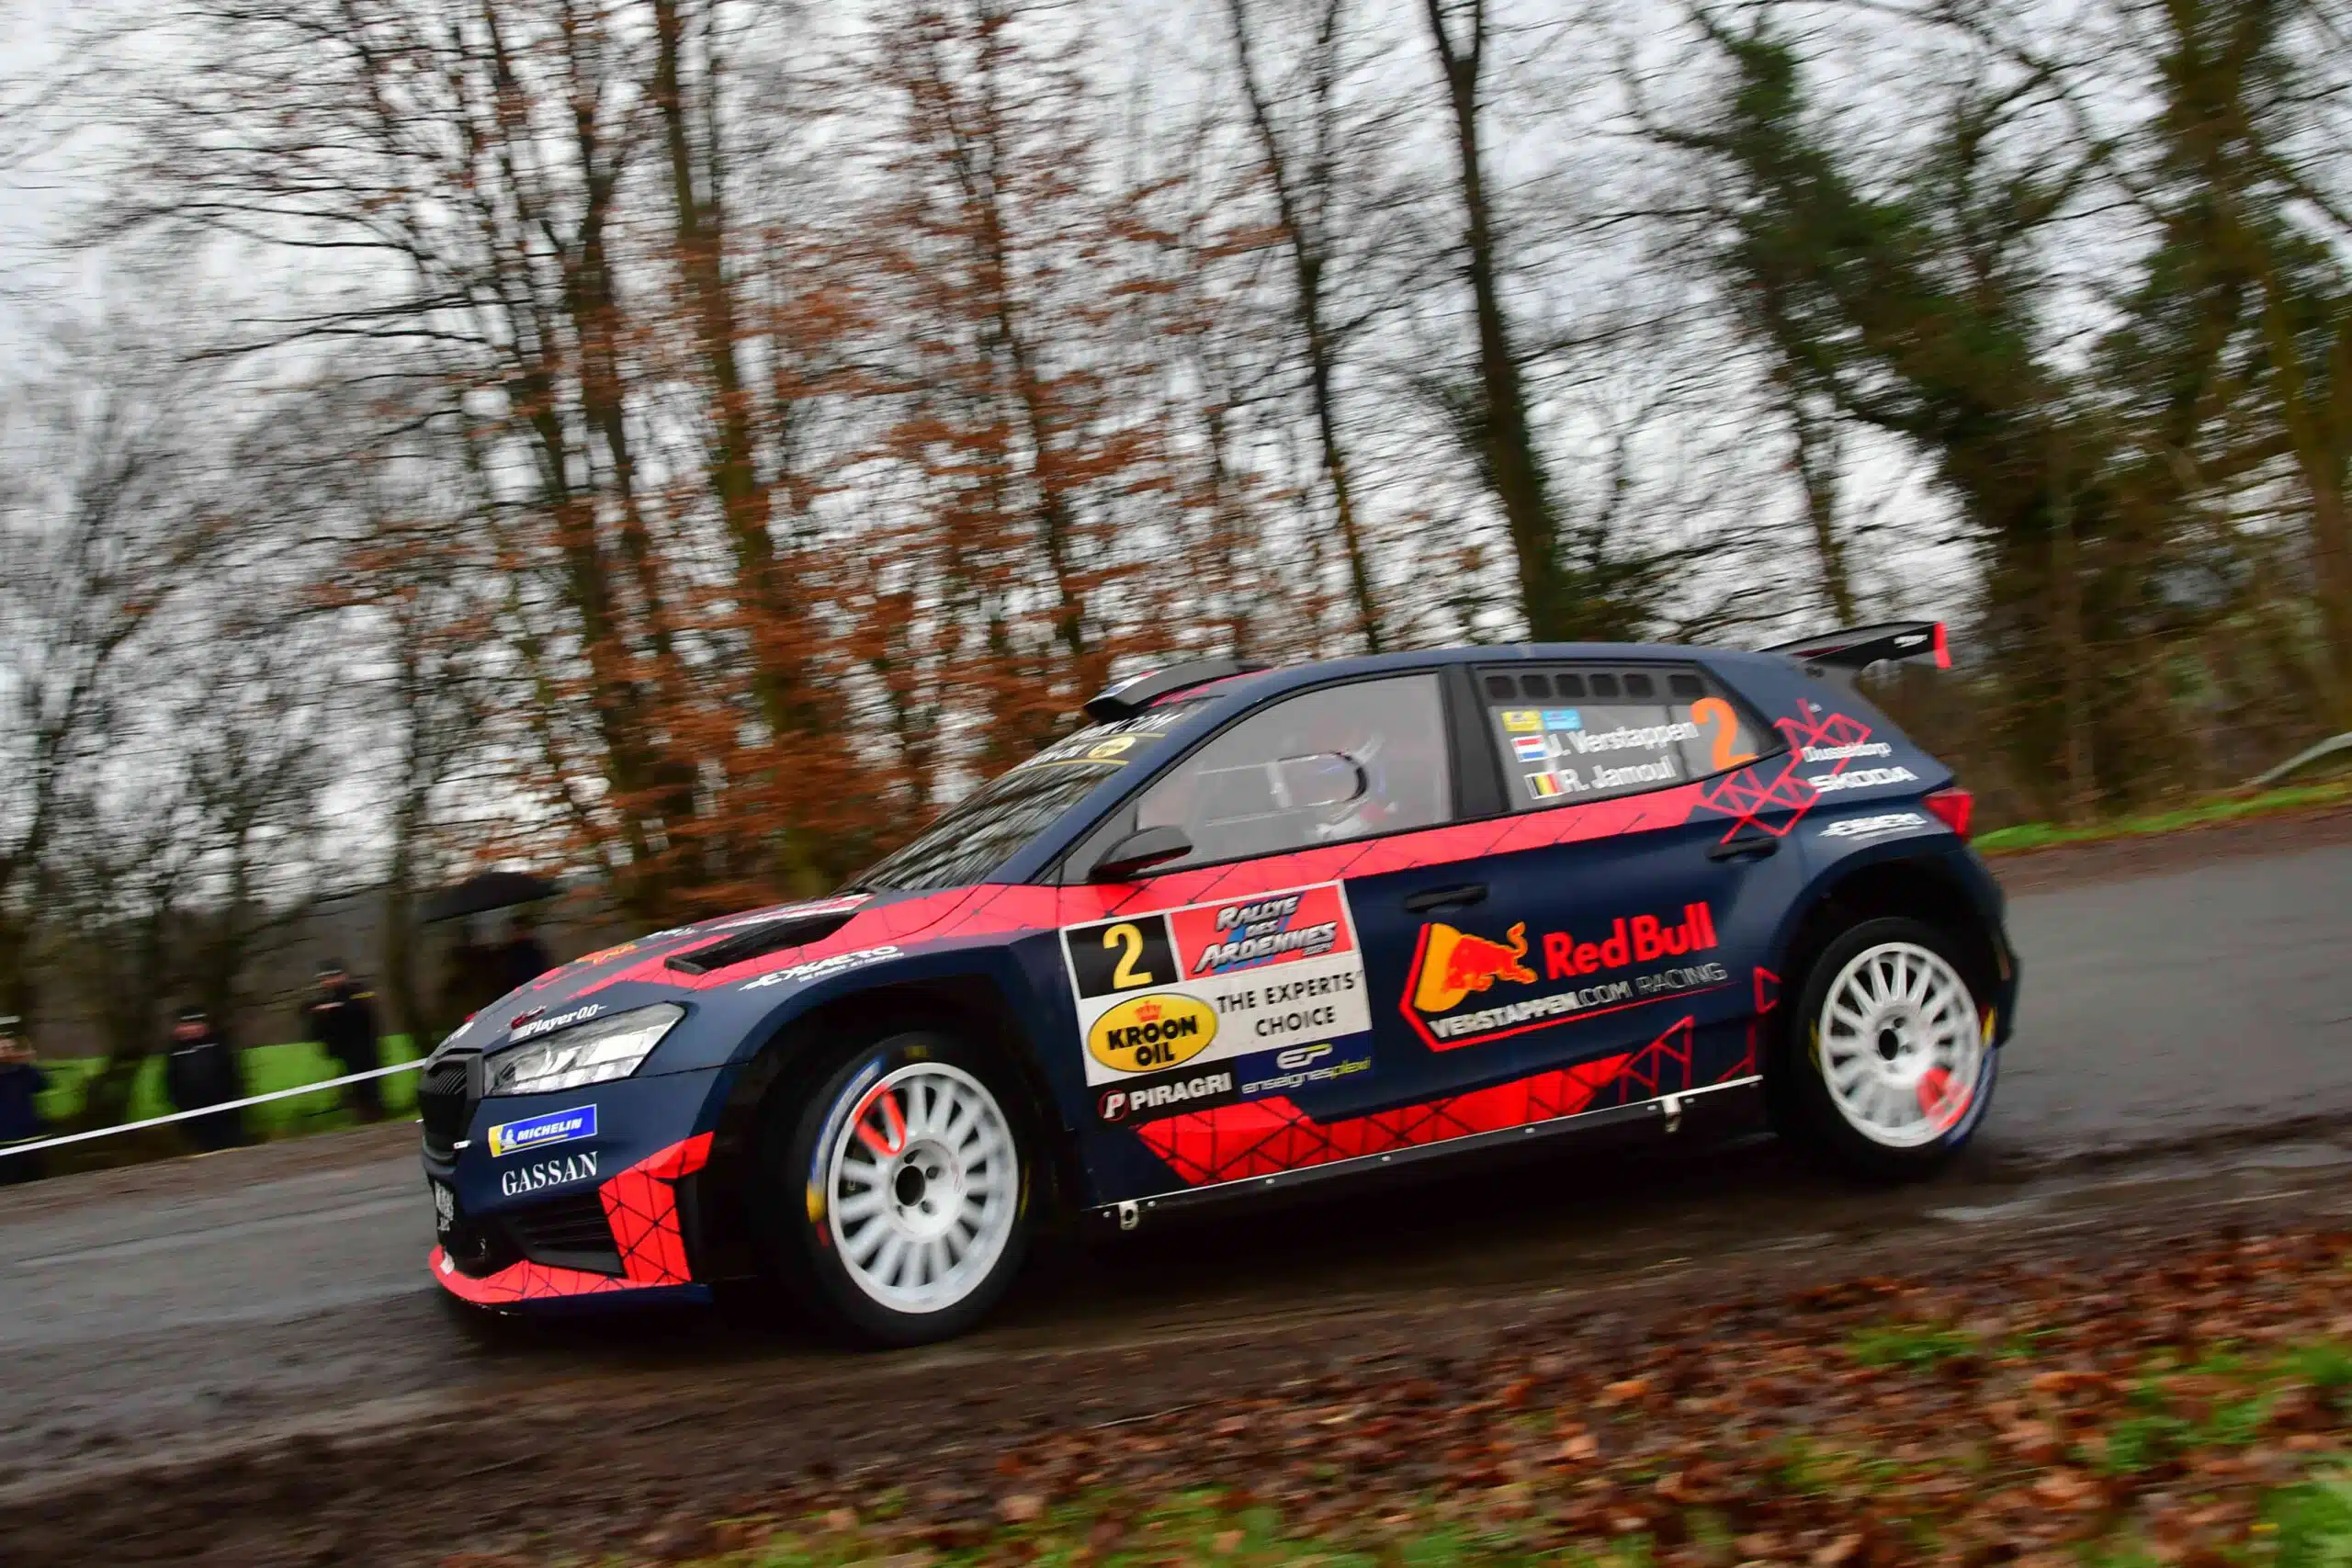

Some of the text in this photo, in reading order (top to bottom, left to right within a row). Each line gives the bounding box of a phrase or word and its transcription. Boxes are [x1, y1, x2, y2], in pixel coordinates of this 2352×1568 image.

[1566, 721, 1699, 753] Verstappen
[1690, 697, 1758, 772] 2
[1102, 922, 1153, 990] 2
[1192, 920, 1339, 975] ARDENNES
[1542, 901, 1719, 980] Red Bull
[1216, 990, 1256, 1014] THE
[1427, 962, 1729, 1039] VERSTAPPEN.COM RACING
[526, 1011, 577, 1036] Player
[1107, 1014, 1198, 1050] KROON
[1255, 1006, 1336, 1037] CHOICE
[1136, 1042, 1176, 1066] OIL
[1129, 1072, 1233, 1111] PIRAGRI
[516, 1117, 583, 1142] MICHELIN
[502, 1150, 598, 1197] GASSAN
